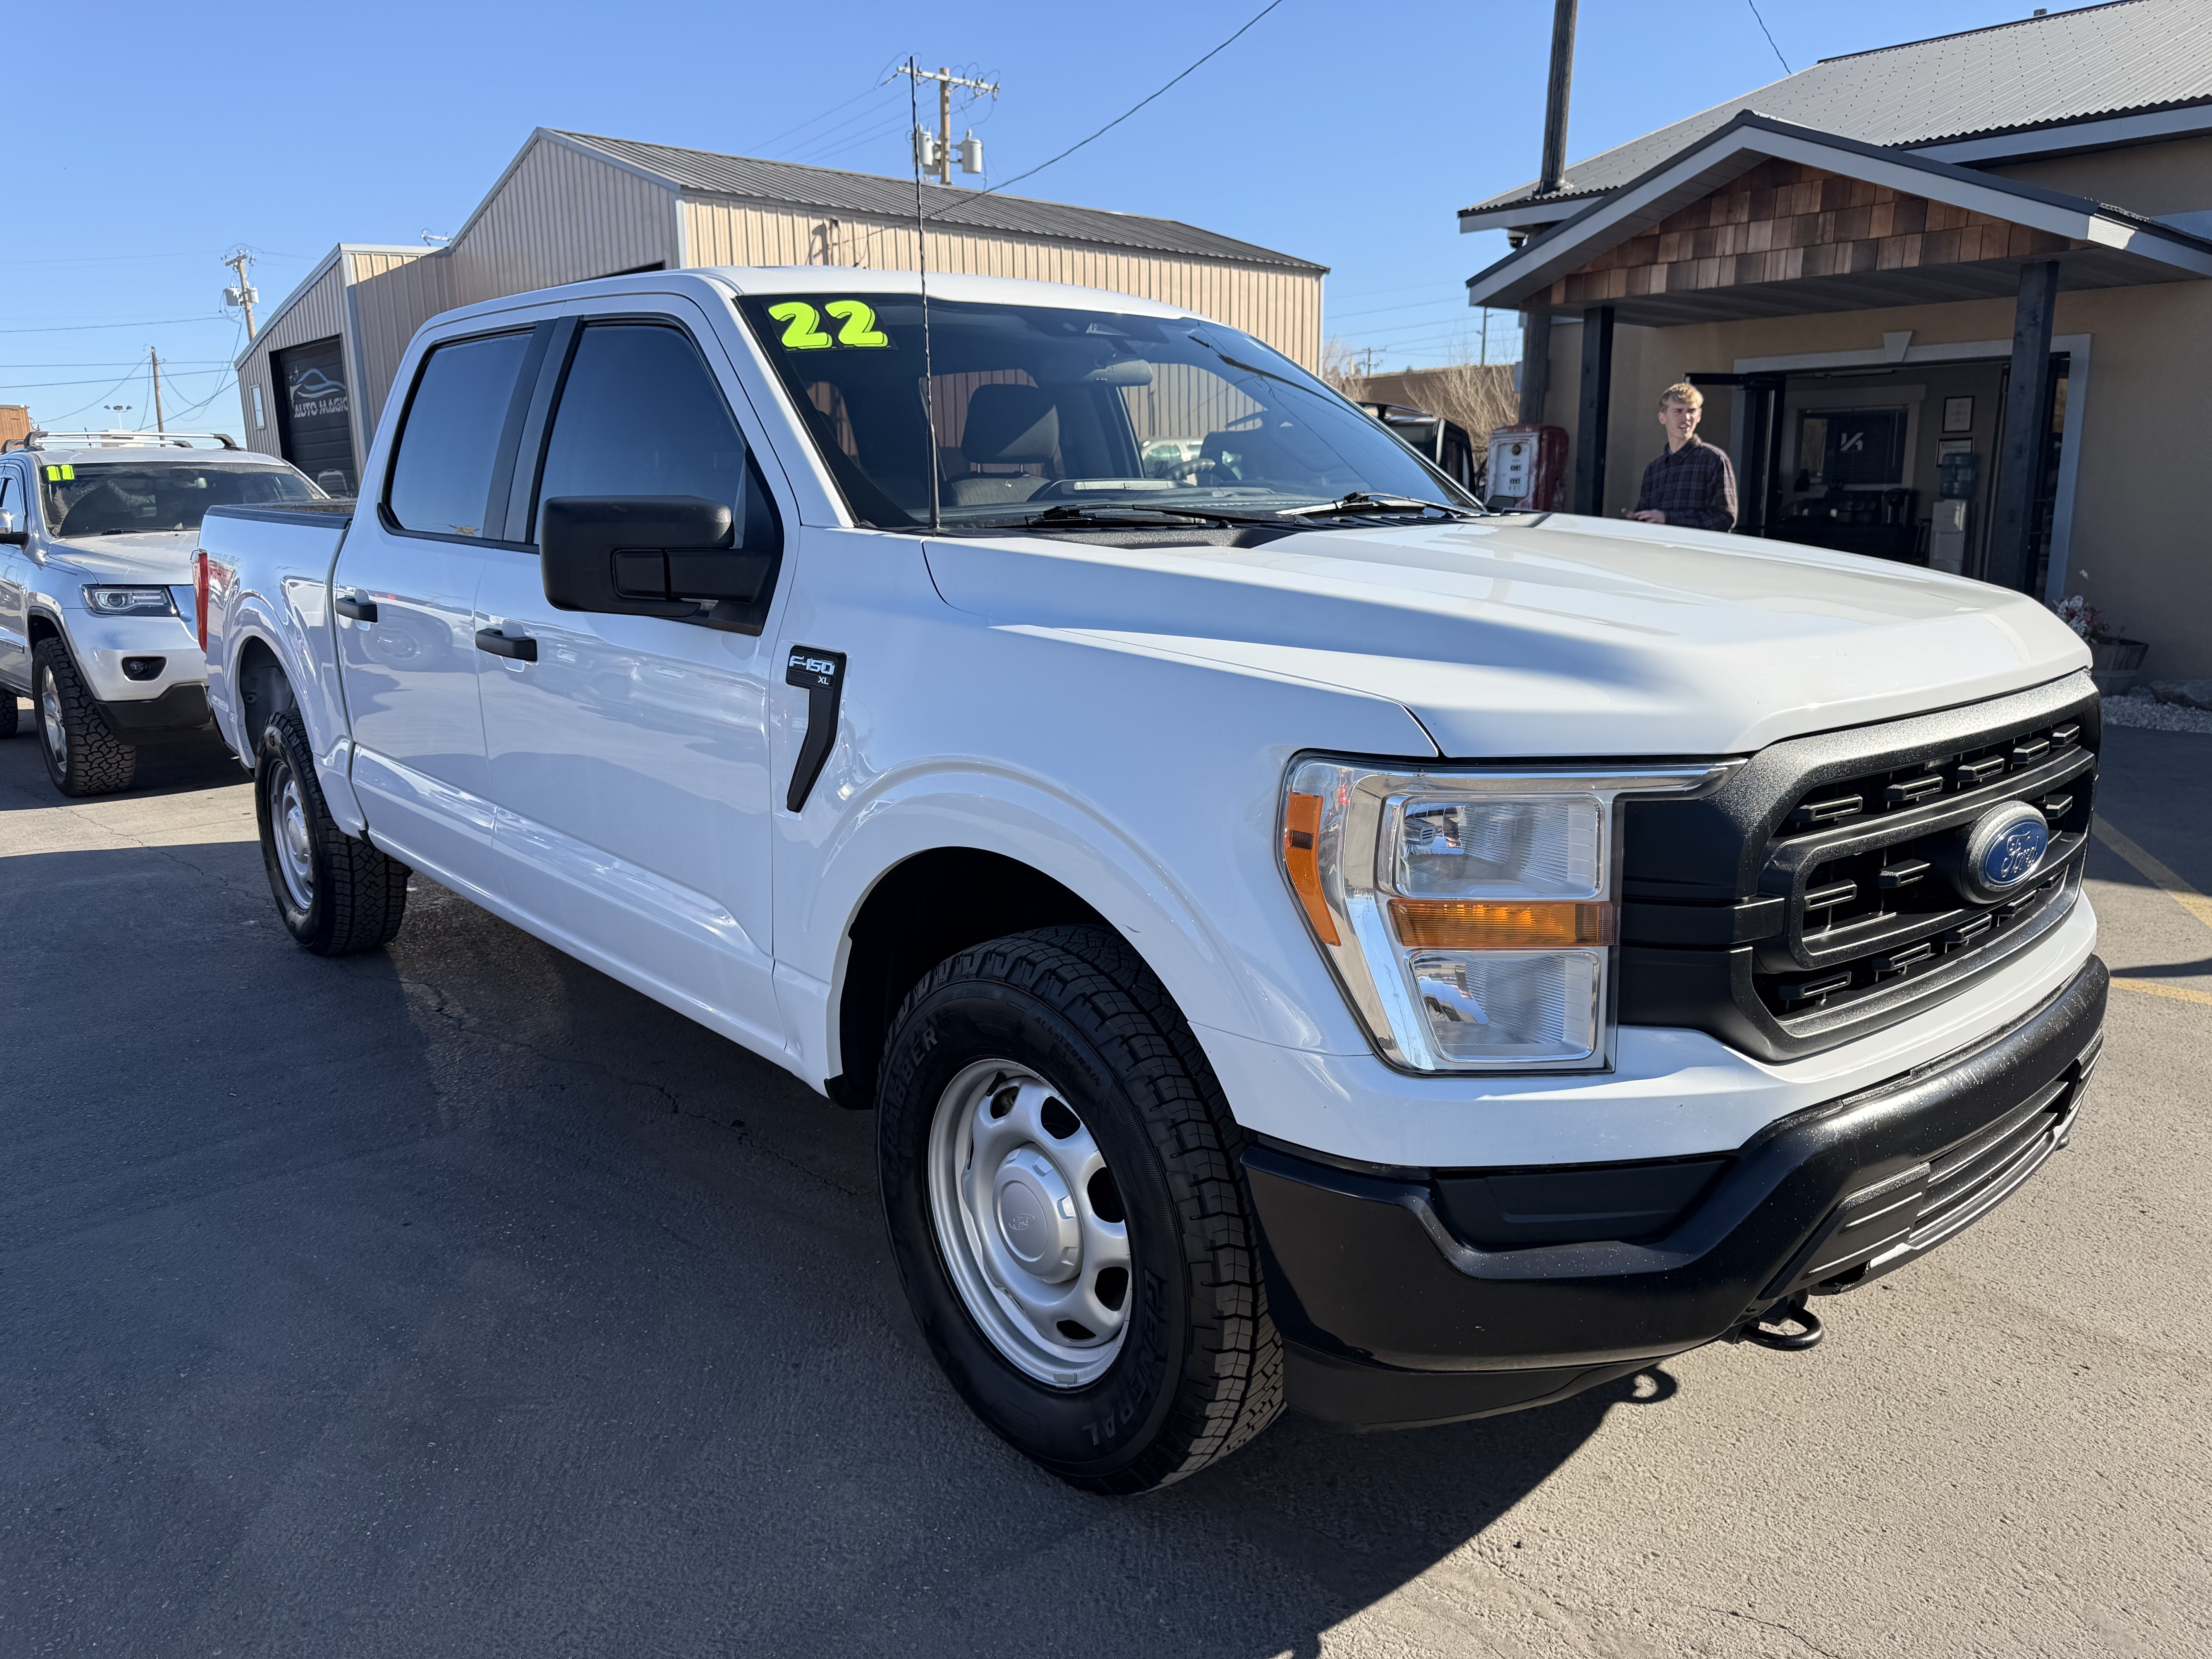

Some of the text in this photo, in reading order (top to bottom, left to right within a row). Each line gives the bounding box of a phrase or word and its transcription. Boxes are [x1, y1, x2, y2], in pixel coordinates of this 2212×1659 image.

[768, 301, 888, 349] 22
[294, 396, 348, 418] AUTO MAGIC
[47, 464, 75, 481] 11
[789, 655, 835, 675] F-150
[818, 676, 829, 685] XL
[2001, 831, 2039, 878] Ford
[1082, 1269, 1163, 1446] GENERAL
